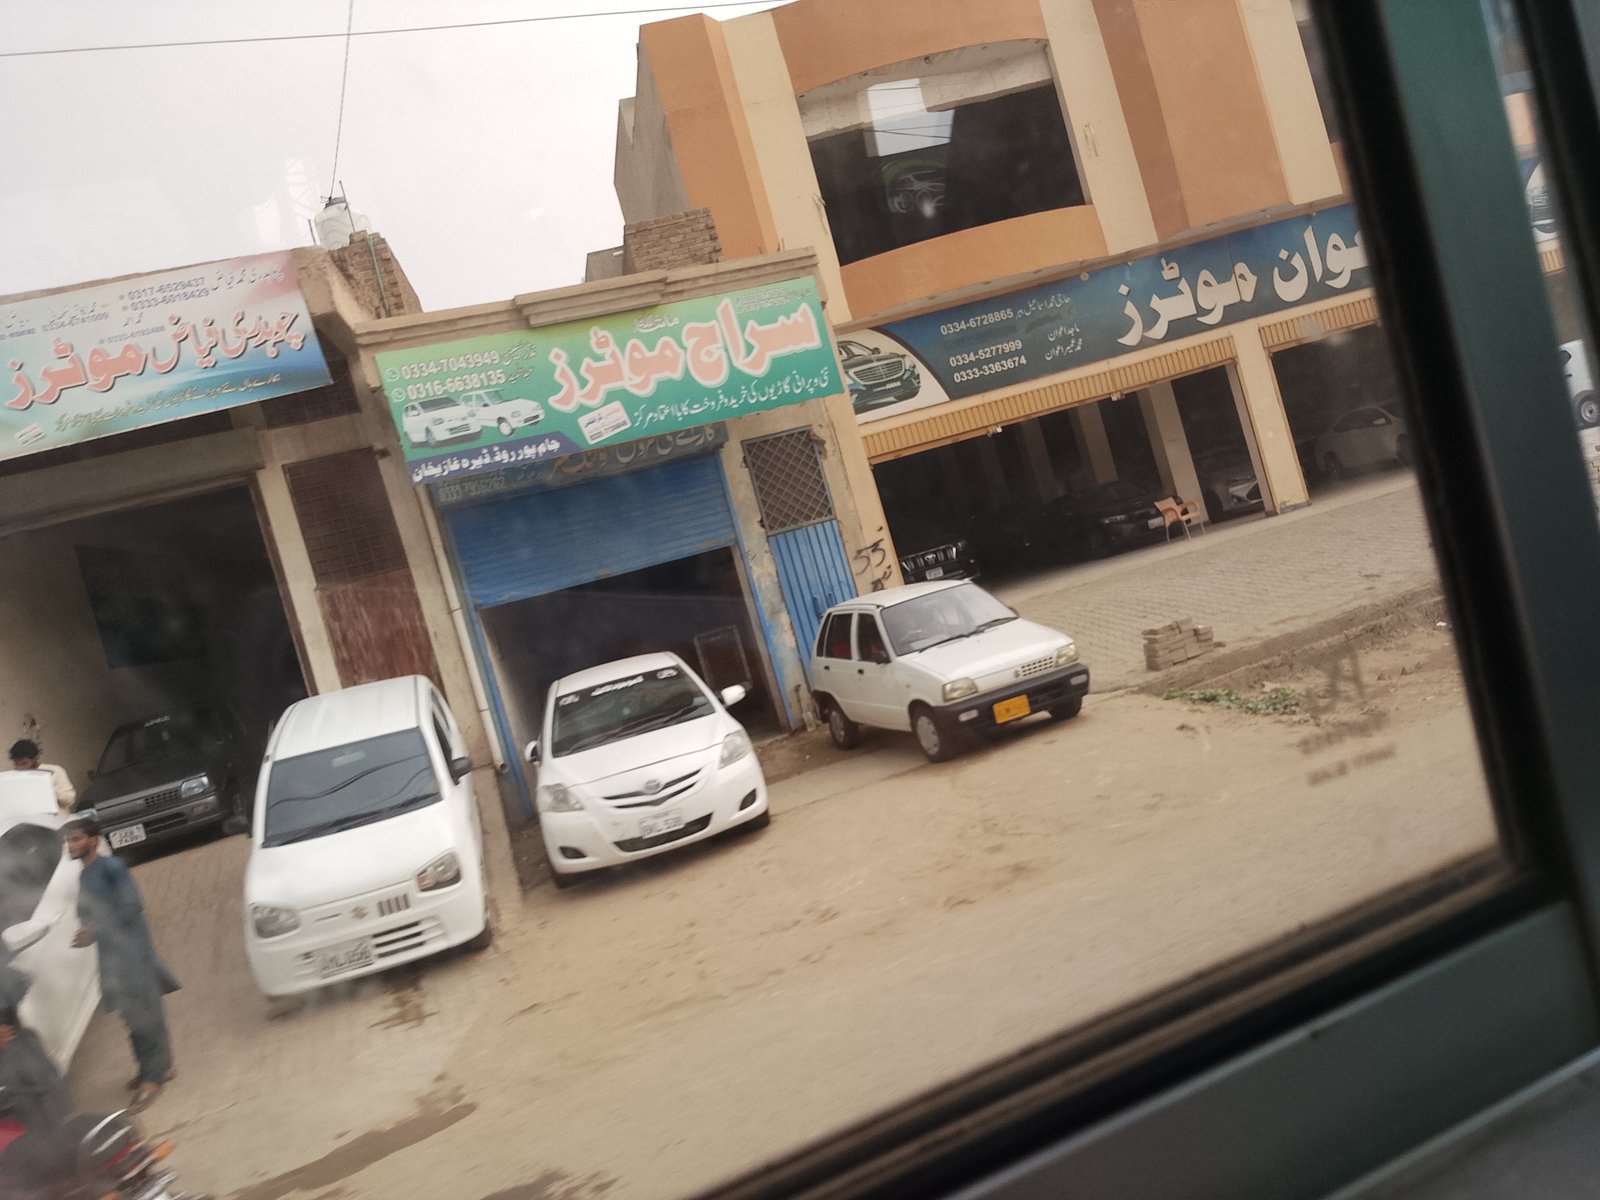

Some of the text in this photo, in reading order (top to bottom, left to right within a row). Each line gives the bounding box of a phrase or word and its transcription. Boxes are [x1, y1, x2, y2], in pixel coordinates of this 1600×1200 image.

[1117, 257, 1257, 346] موٹرز
[940, 308, 1014, 335] 0334-6728865
[400, 350, 500, 380] 0334-7043949
[547, 298, 822, 412] سراج موٹرز
[949, 339, 1023, 367] 0334-5277999
[4, 338, 149, 411] موٹرز
[406, 368, 507, 400] 0316-6638135
[953, 355, 1027, 383] 0333-3363674
